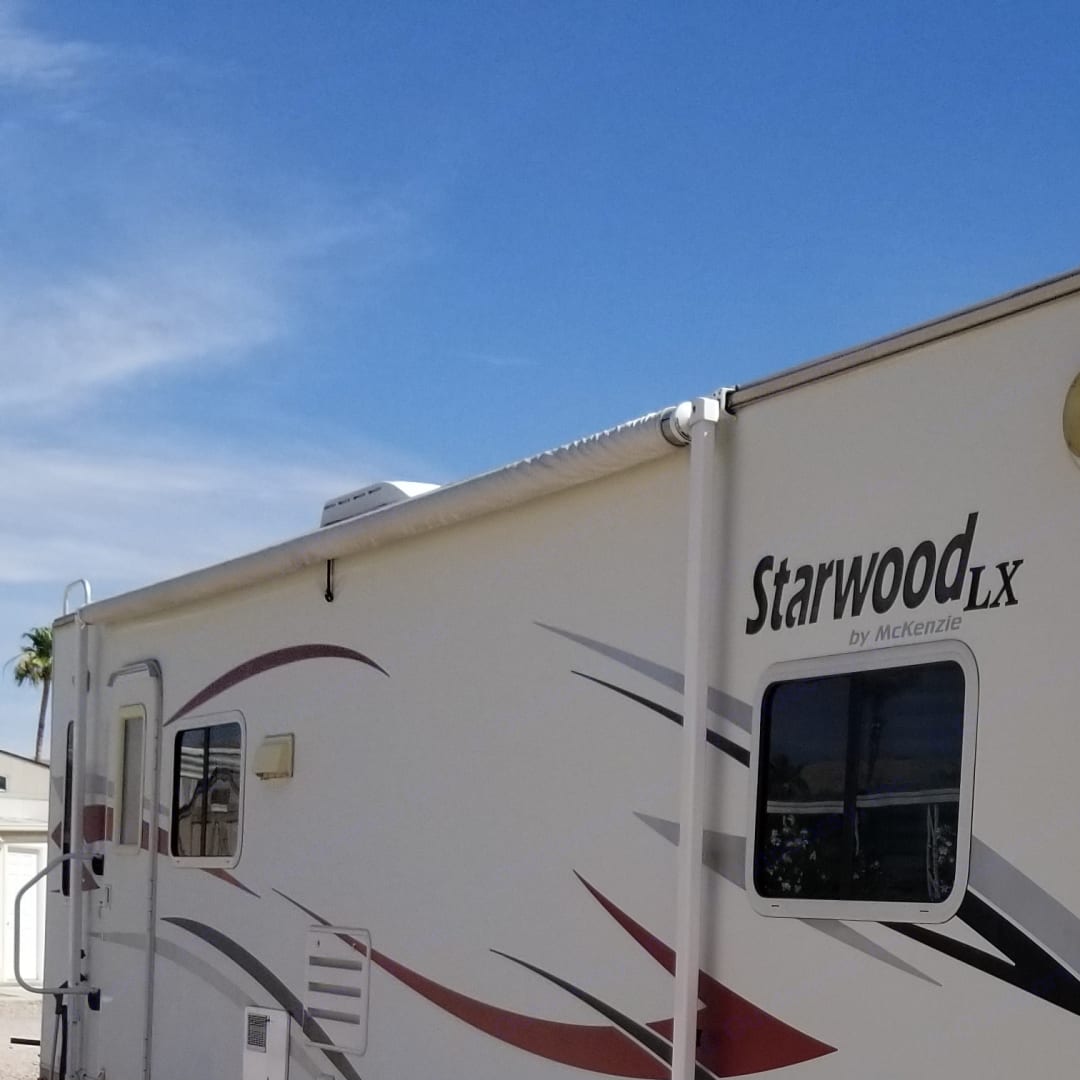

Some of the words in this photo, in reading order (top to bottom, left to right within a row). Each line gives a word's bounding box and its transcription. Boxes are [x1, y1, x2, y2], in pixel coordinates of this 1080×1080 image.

[745, 511, 979, 635] Starwood
[963, 559, 1024, 612] LX
[848, 629, 870, 647] by
[874, 615, 962, 642] McKenzie
